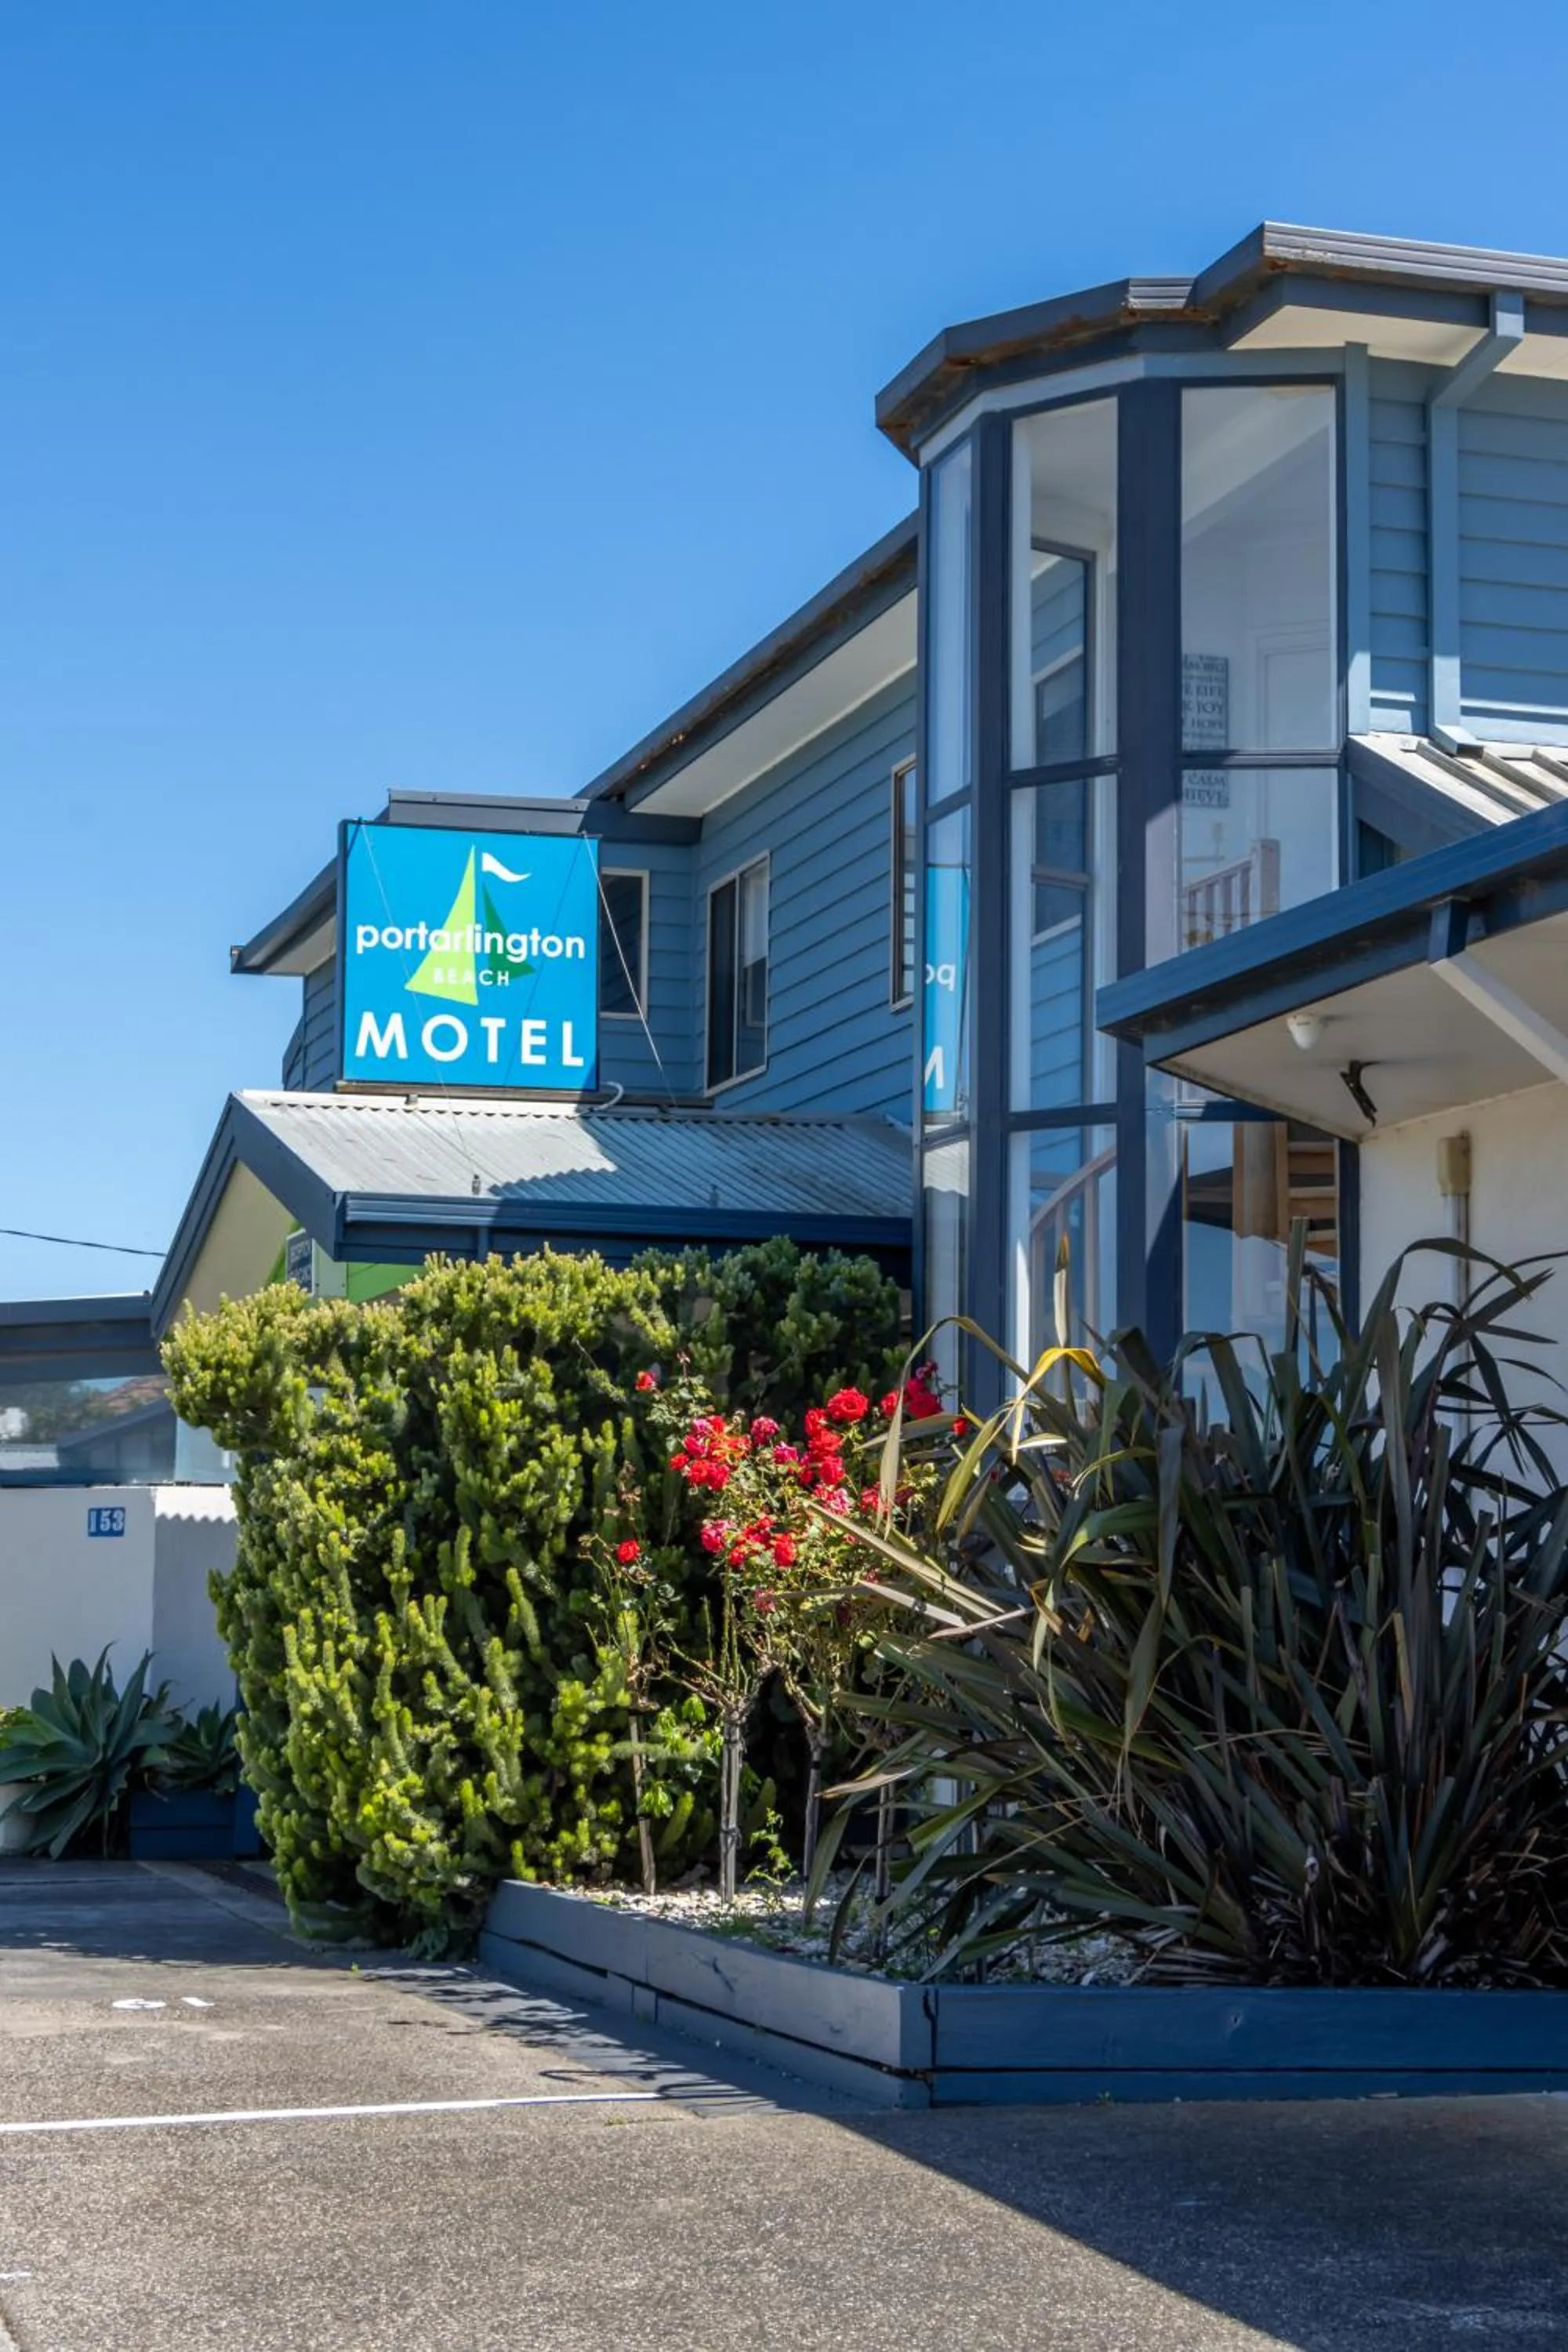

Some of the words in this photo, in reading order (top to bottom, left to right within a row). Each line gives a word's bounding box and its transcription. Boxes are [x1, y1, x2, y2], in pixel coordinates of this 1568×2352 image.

[356, 921, 586, 963] portarlington
[433, 968, 509, 986] BEACH
[354, 1011, 584, 1067] MOTEL
[90, 1509, 124, 1532] 153
